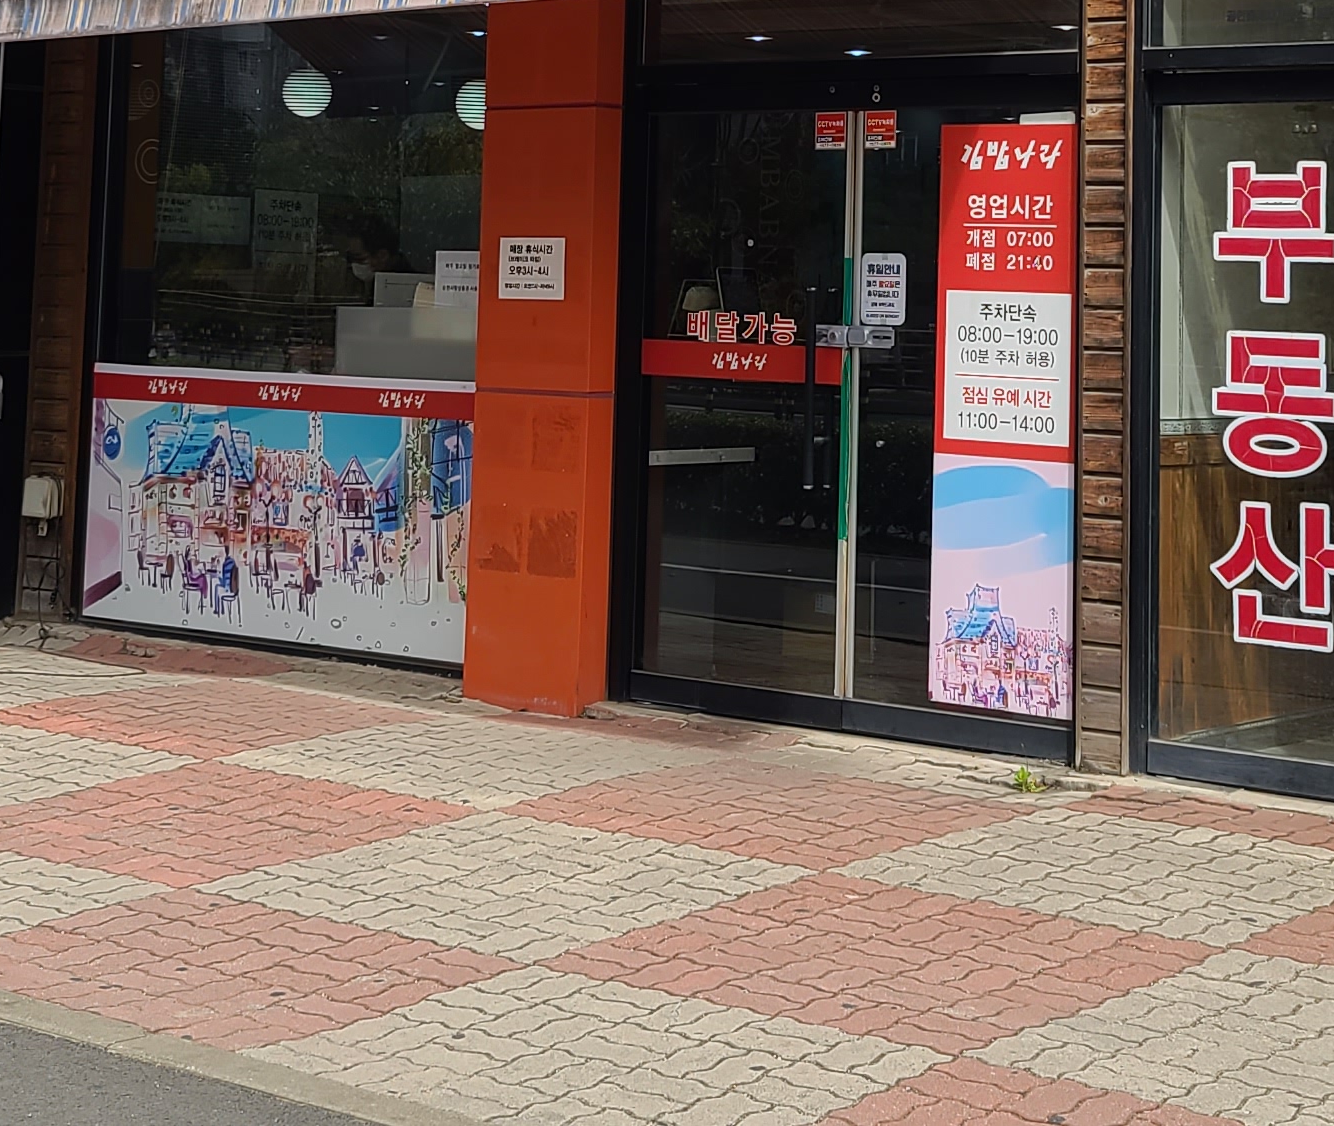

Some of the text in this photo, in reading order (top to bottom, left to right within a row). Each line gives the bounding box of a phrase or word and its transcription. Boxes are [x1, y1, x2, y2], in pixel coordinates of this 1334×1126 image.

[961, 139, 1064, 171] 김밥나라
[967, 194, 1054, 221] 영업시간
[509, 244, 553, 254] 매장 휴식시간
[966, 229, 1054, 249] 개점 07:00
[866, 263, 901, 275] 휴일안내
[965, 252, 1054, 272] 폐점 21:40
[979, 303, 1037, 323] 주차단속
[686, 310, 798, 347] 배달가능
[957, 326, 1059, 347] 08:00-19:00
[711, 351, 768, 372] 김밥나라
[960, 348, 1056, 369] (10분 주차 허용)
[147, 378, 189, 397] 김밥나라
[258, 384, 302, 403] 김밥나라
[378, 391, 425, 410] 김밥나라
[962, 386, 1052, 410] 점심 유예 시간
[957, 411, 1055, 434] 11:00-14:00
